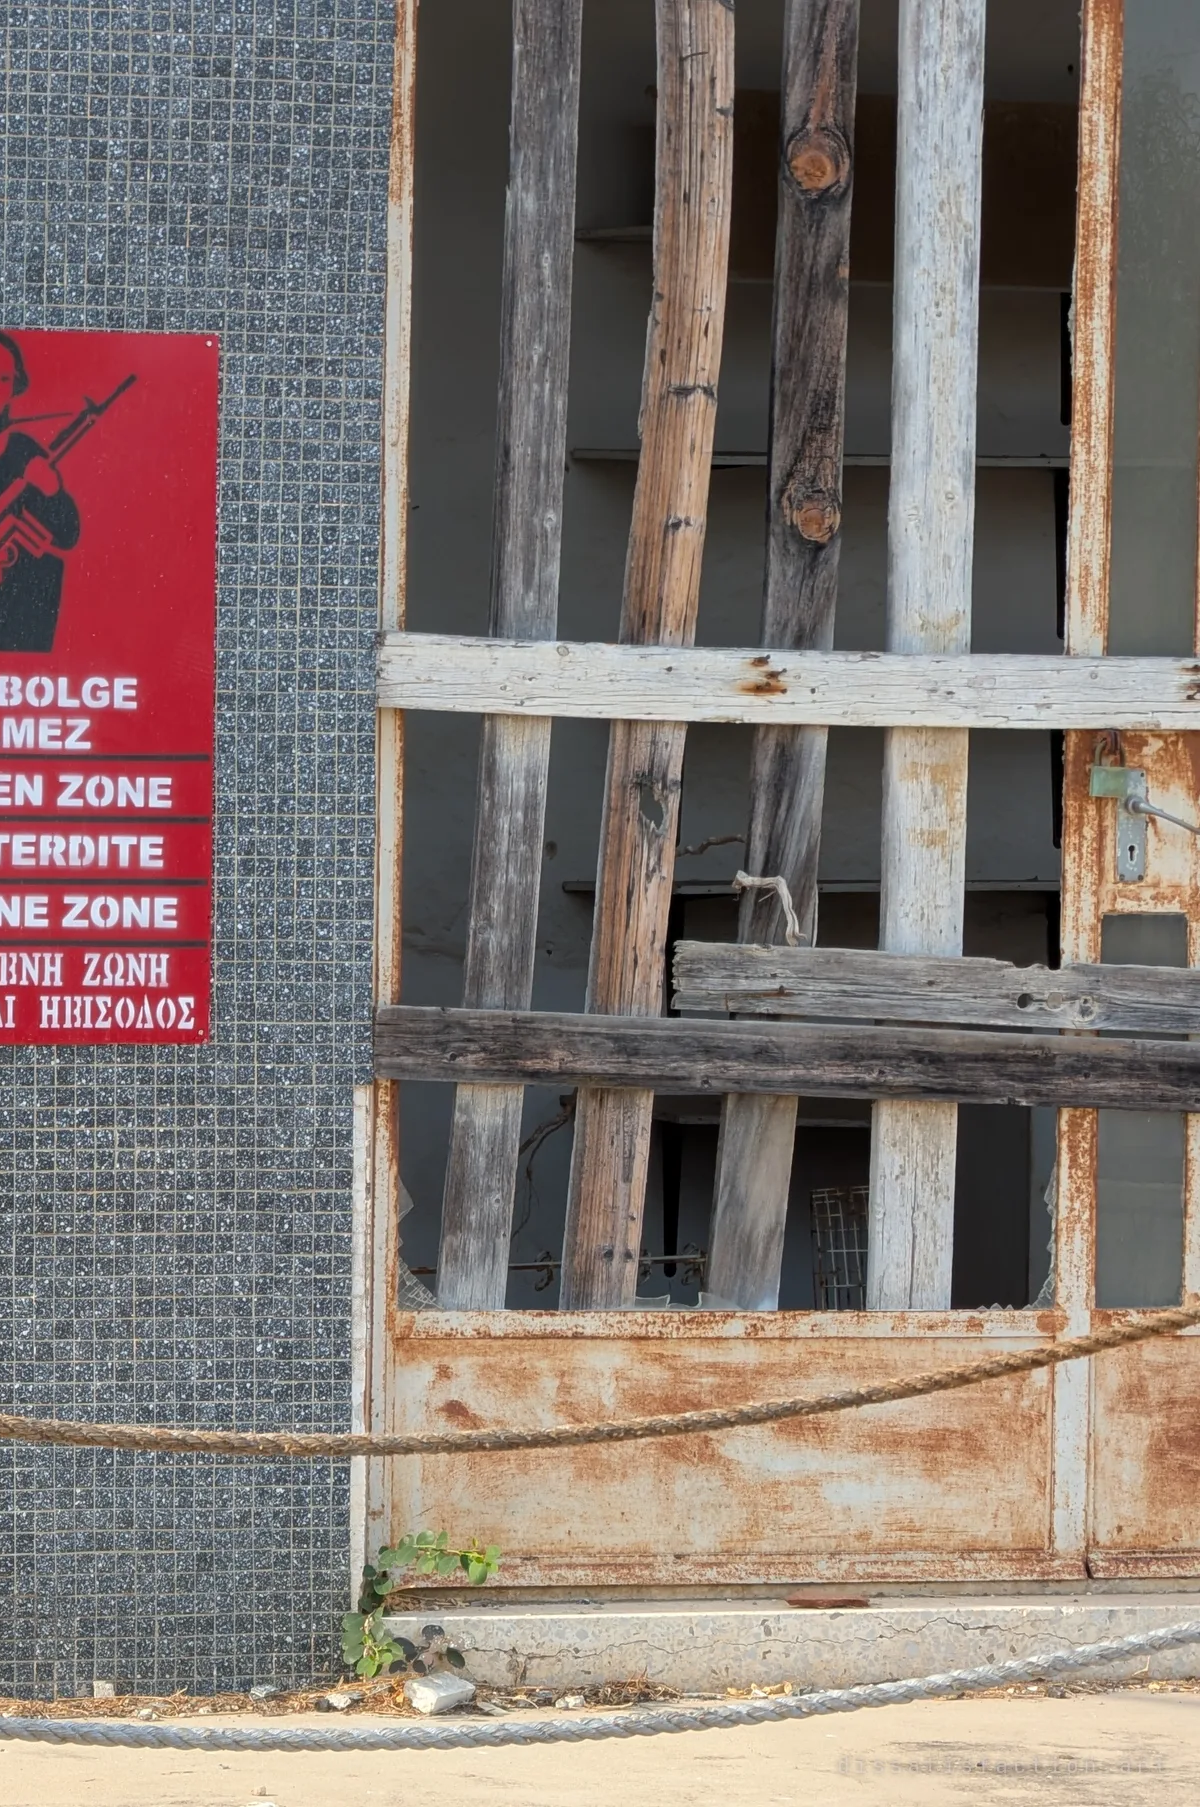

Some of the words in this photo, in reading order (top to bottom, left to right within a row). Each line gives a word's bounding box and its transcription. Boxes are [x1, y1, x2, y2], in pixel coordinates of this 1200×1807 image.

[57, 774, 173, 808] ZONE
[62, 895, 178, 929] ZONE
[82, 952, 170, 987] ΖΩΝΗ
